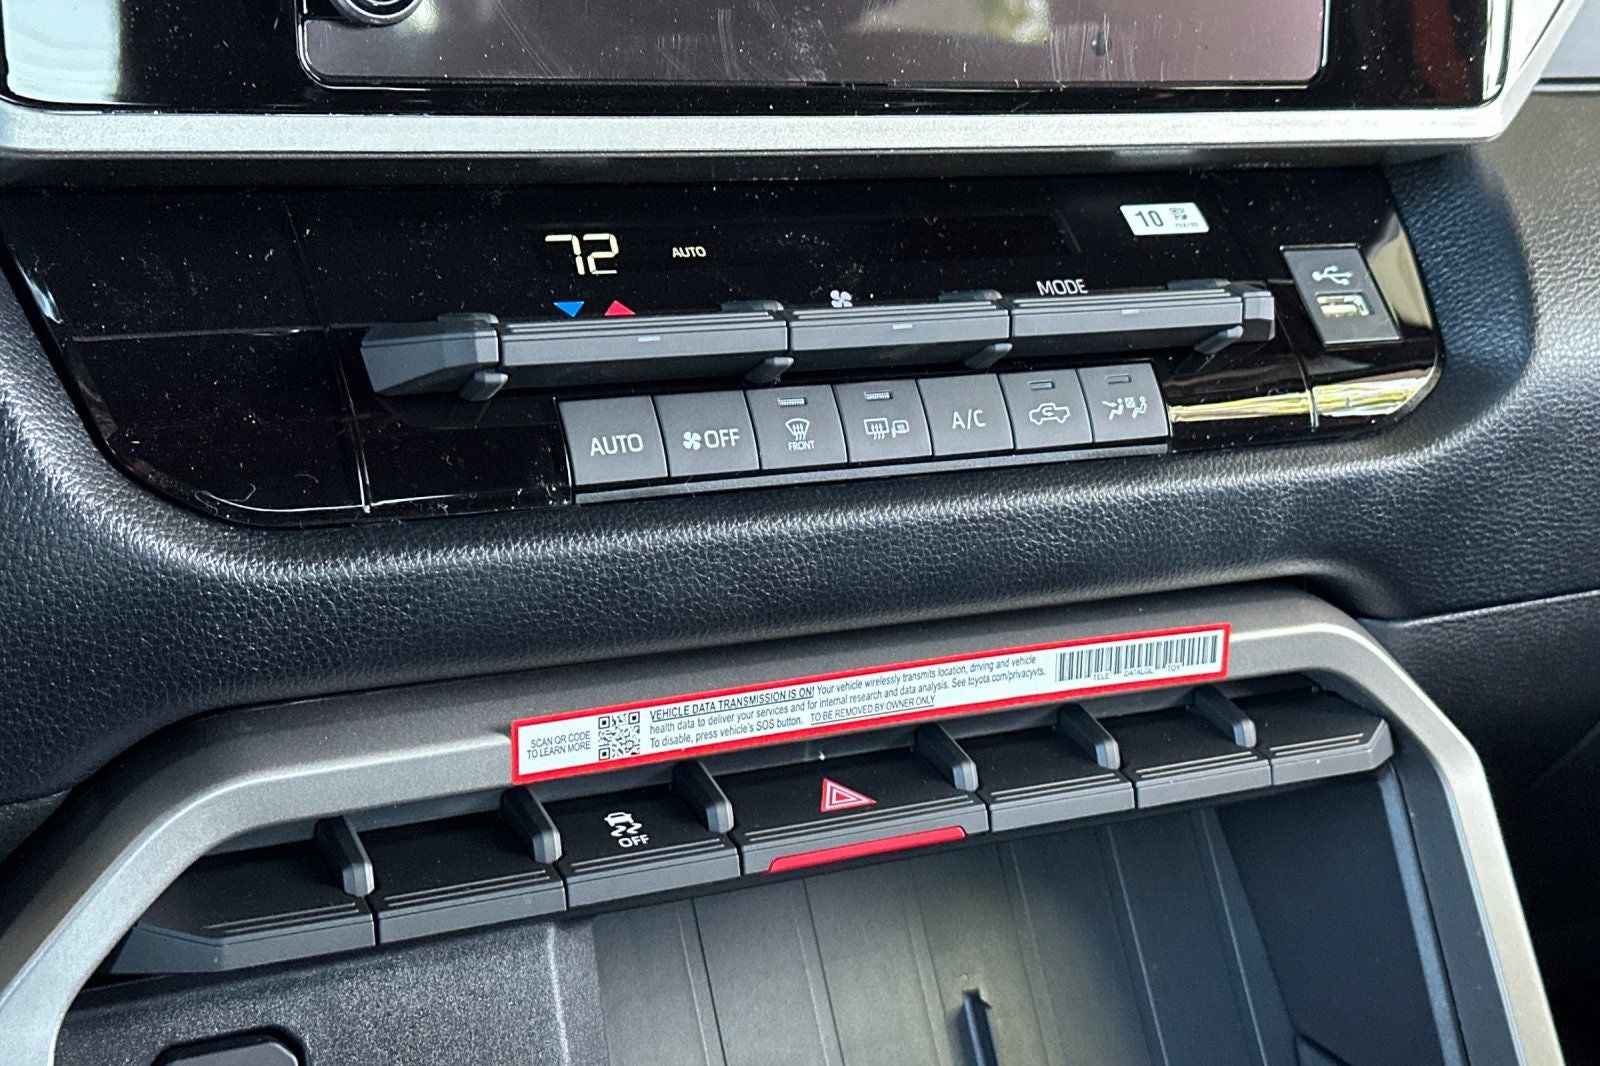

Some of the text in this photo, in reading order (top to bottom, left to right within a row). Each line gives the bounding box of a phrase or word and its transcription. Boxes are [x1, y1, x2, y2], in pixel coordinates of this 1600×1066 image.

[1134, 210, 1164, 228] 10
[545, 233, 619, 275] 72
[672, 246, 707, 258] AUTO
[1036, 279, 1088, 296] MODE
[952, 409, 986, 430] A/C
[590, 433, 644, 456] AUTO
[704, 428, 740, 449] OFF
[788, 440, 815, 451] FRONT
[650, 654, 1037, 721] VEHICLE DATA TRANSMISSION IS ON! Your vehicle wirelessly transmits location, driving and vehicle
[649, 721, 675, 735] health
[677, 718, 695, 731] data
[697, 716, 706, 728] to
[707, 713, 735, 726] deliver
[736, 710, 755, 724] your
[756, 705, 789, 718] services
[790, 701, 805, 713] and
[806, 699, 818, 711] for
[819, 694, 848, 708] internal
[849, 688, 883, 703] research
[884, 686, 899, 699] and
[900, 684, 917, 696] data
[917, 680, 950, 694] analysis.
[951, 677, 967, 688] See
[650, 694, 936, 749] To disable, press vehicle's SOS button. TO BE REMOVED BY OWNER ONLY
[526, 740, 591, 759] TO LEARN MORE
[531, 736, 553, 749] SCAN
[568, 730, 591, 743] CODE
[618, 834, 649, 848] OFF
